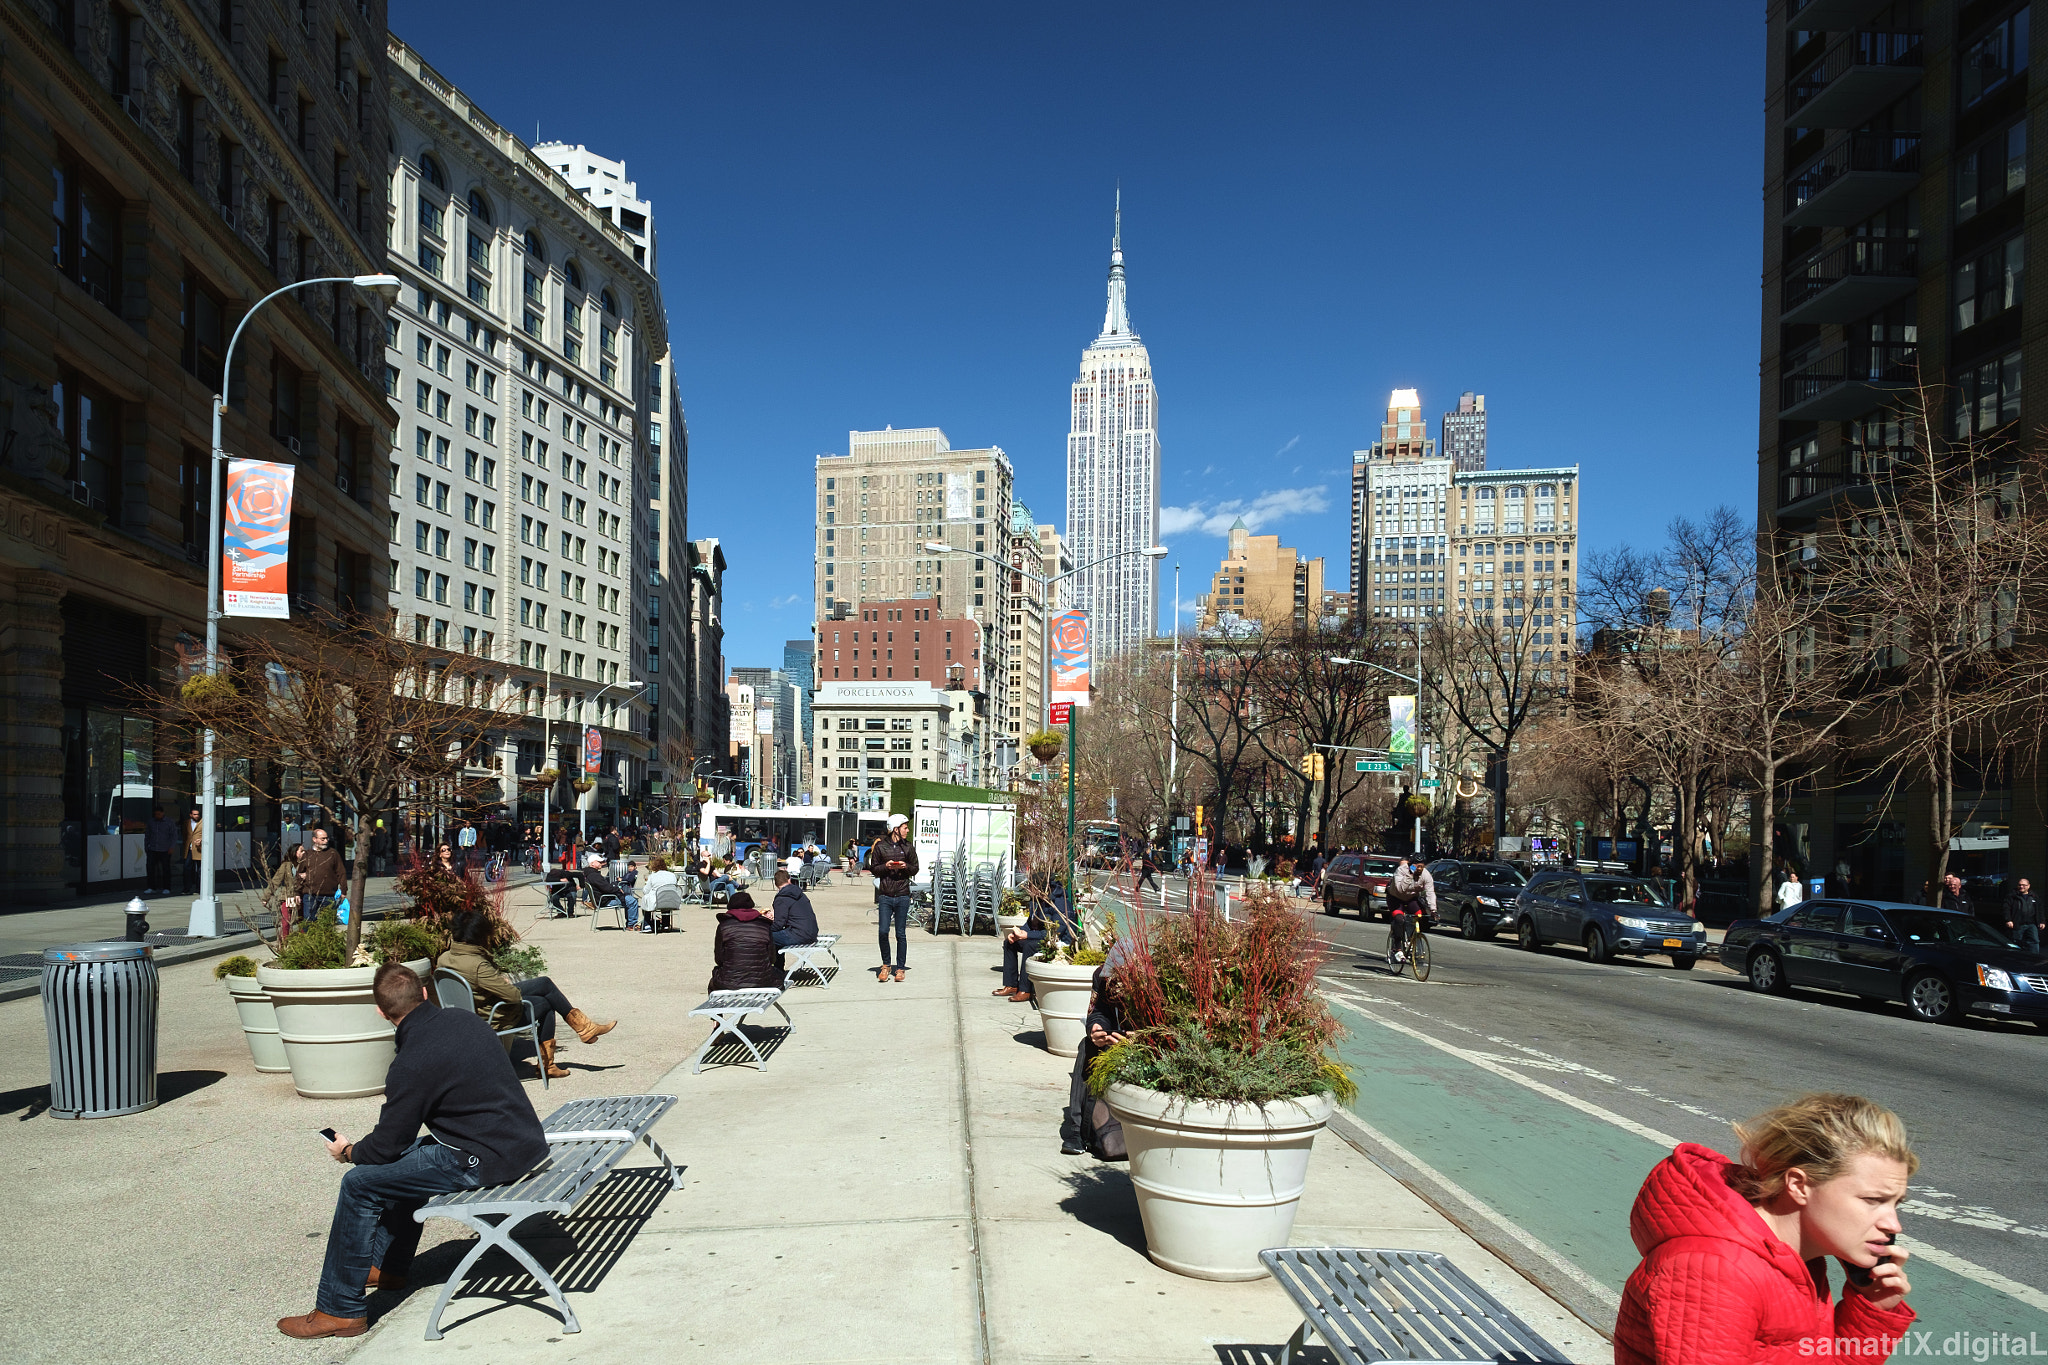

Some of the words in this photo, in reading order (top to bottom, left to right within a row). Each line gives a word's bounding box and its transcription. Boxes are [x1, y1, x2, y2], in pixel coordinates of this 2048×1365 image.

[232, 571, 266, 580] Partnership
[837, 688, 914, 697] PORCELANOSA
[921, 819, 939, 827] FLAT
